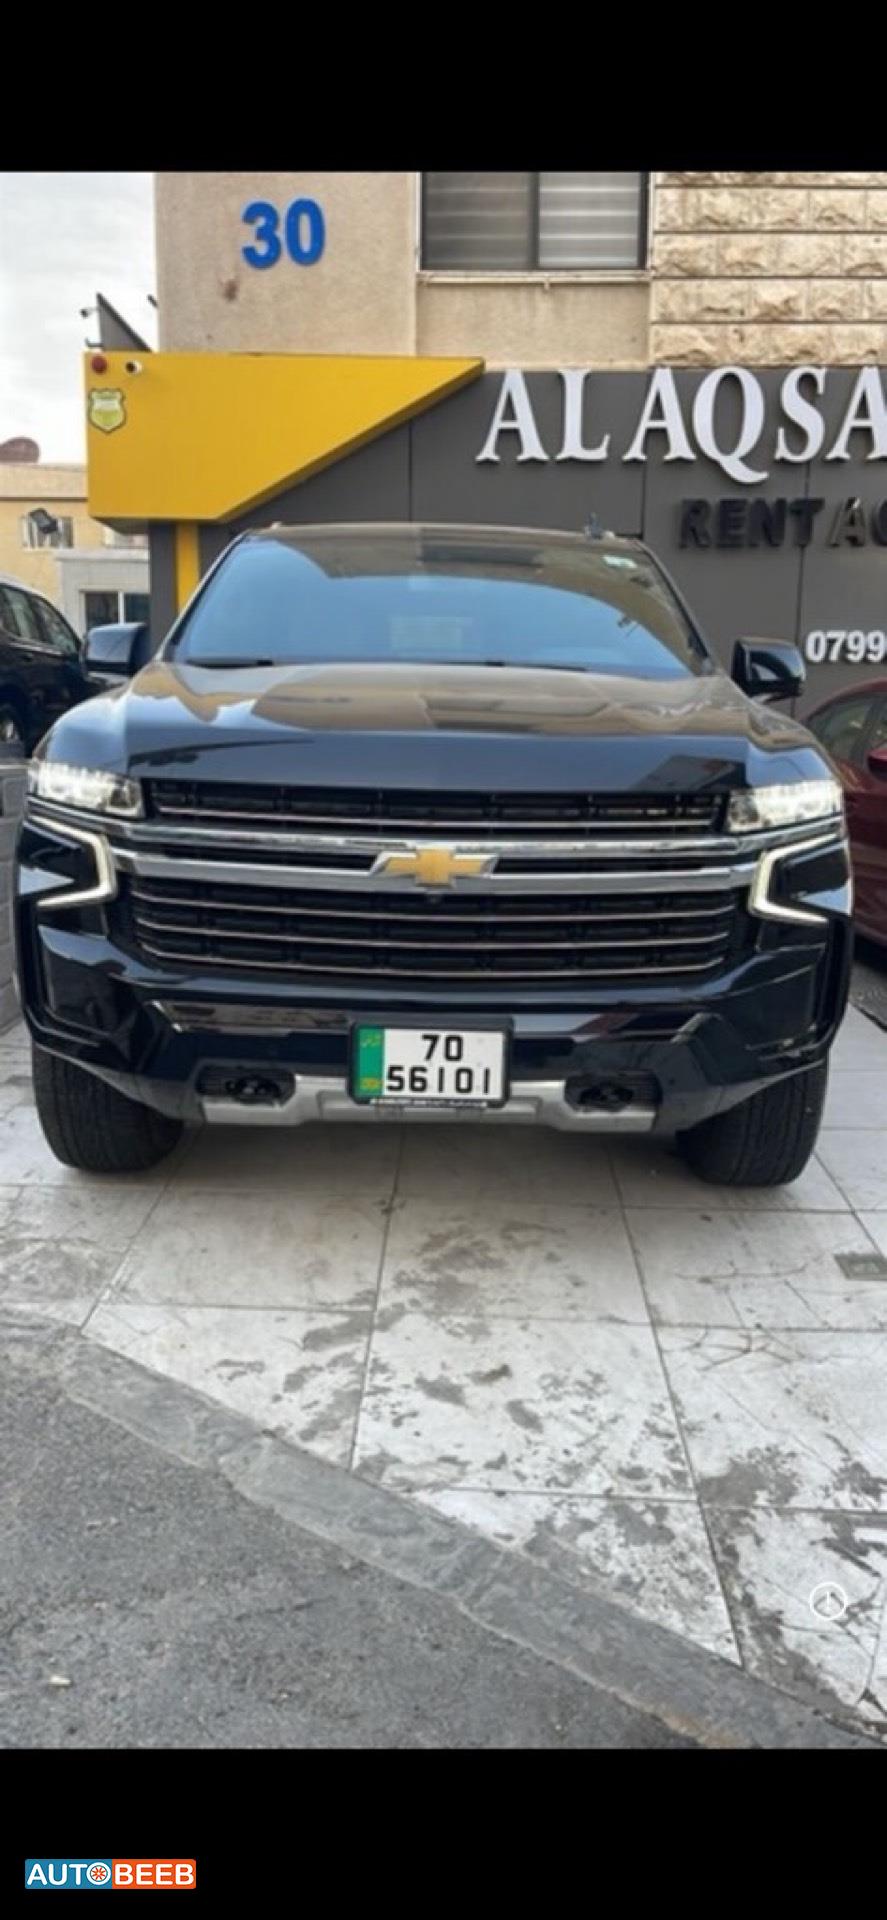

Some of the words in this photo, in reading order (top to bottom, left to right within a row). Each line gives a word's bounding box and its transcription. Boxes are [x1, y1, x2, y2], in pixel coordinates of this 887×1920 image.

[242, 198, 326, 269] 30
[476, 367, 611, 462] AL
[623, 365, 887, 484] AQSA
[680, 496, 825, 548] RENT
[805, 630, 887, 663] 0799
[421, 1034, 464, 1061] 70
[386, 1065, 490, 1094] 56101
